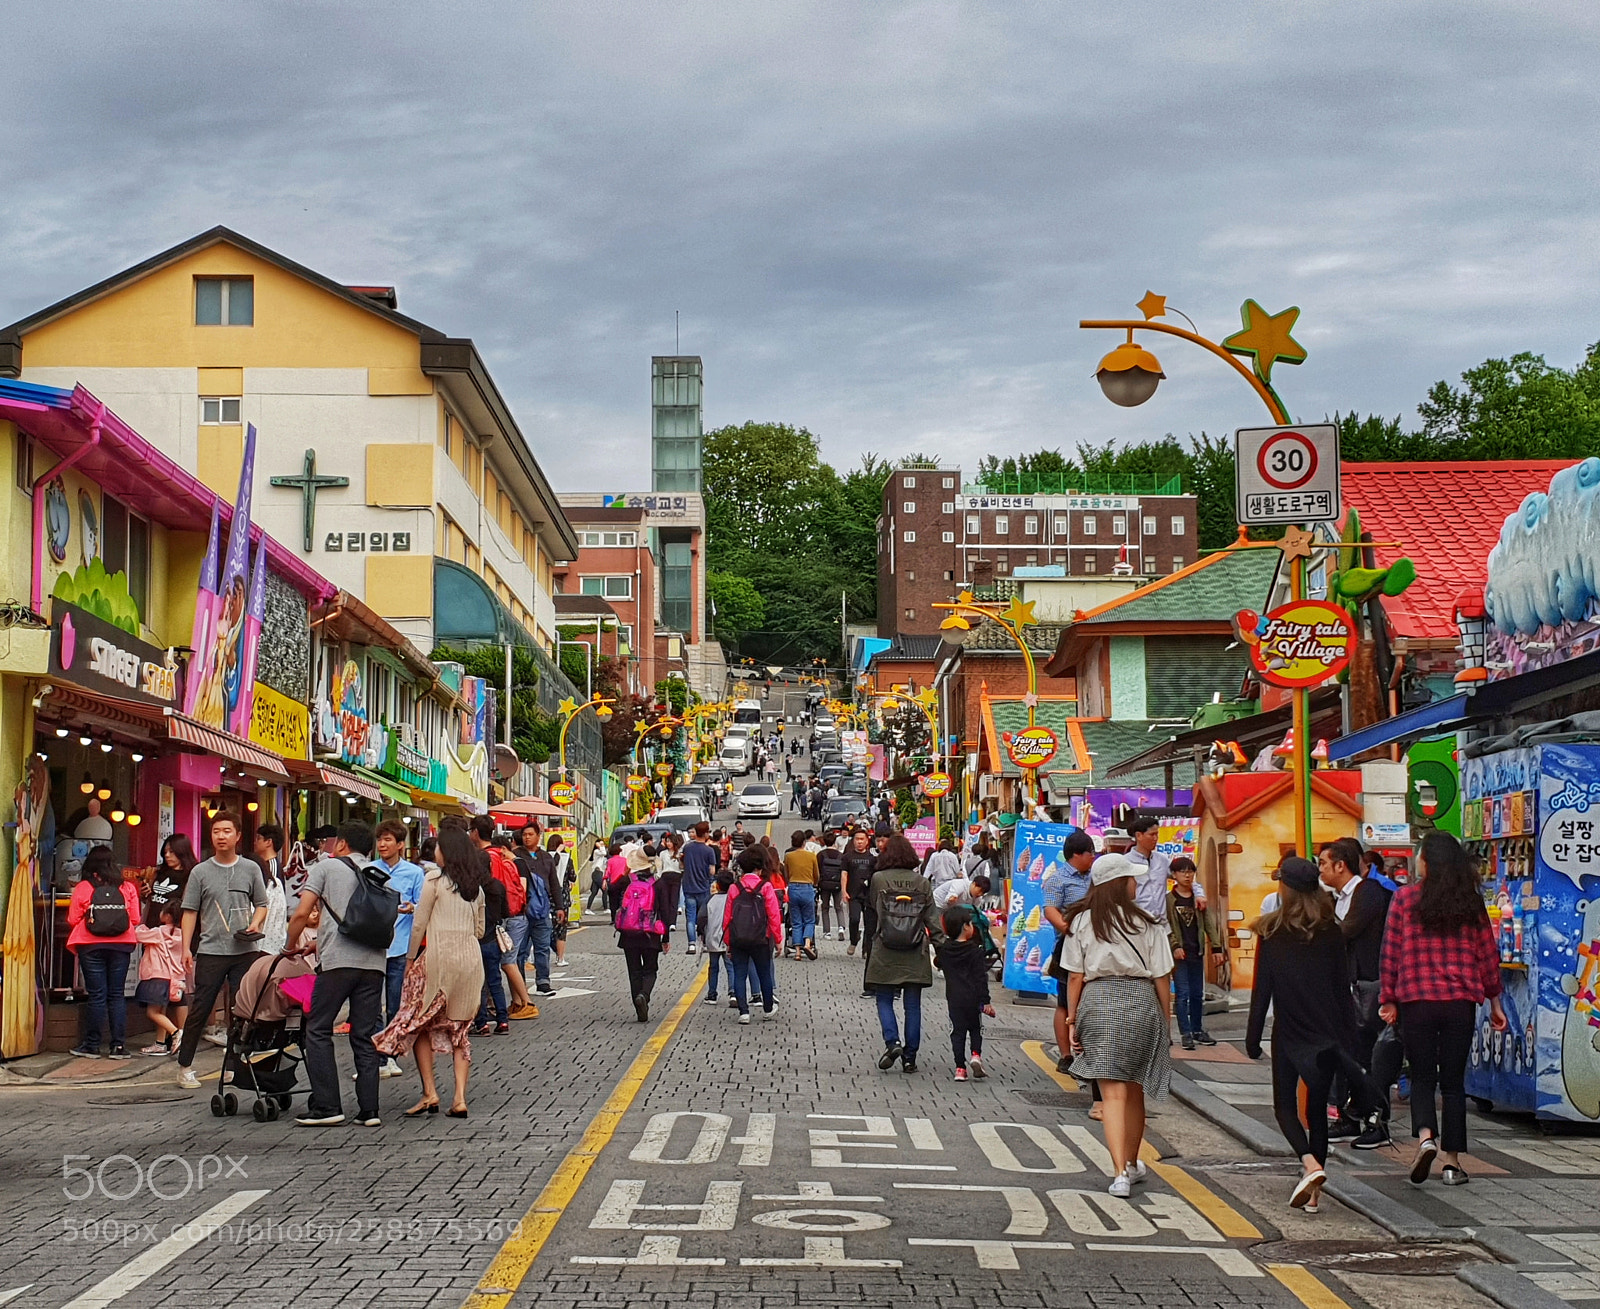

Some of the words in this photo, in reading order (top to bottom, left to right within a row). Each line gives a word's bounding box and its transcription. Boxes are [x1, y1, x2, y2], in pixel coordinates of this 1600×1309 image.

[1271, 449, 1304, 473] 30
[969, 497, 1034, 509] 송월비전센터
[1250, 493, 1328, 515] 생활도로구역
[1261, 619, 1312, 642] Fairy
[1315, 619, 1348, 635] tale
[1278, 640, 1346, 664] Village
[1558, 820, 1595, 841] 설짱
[1553, 843, 1571, 862] 안
[627, 1111, 1117, 1178] 어린이
[569, 1179, 1267, 1278] 보호구역
